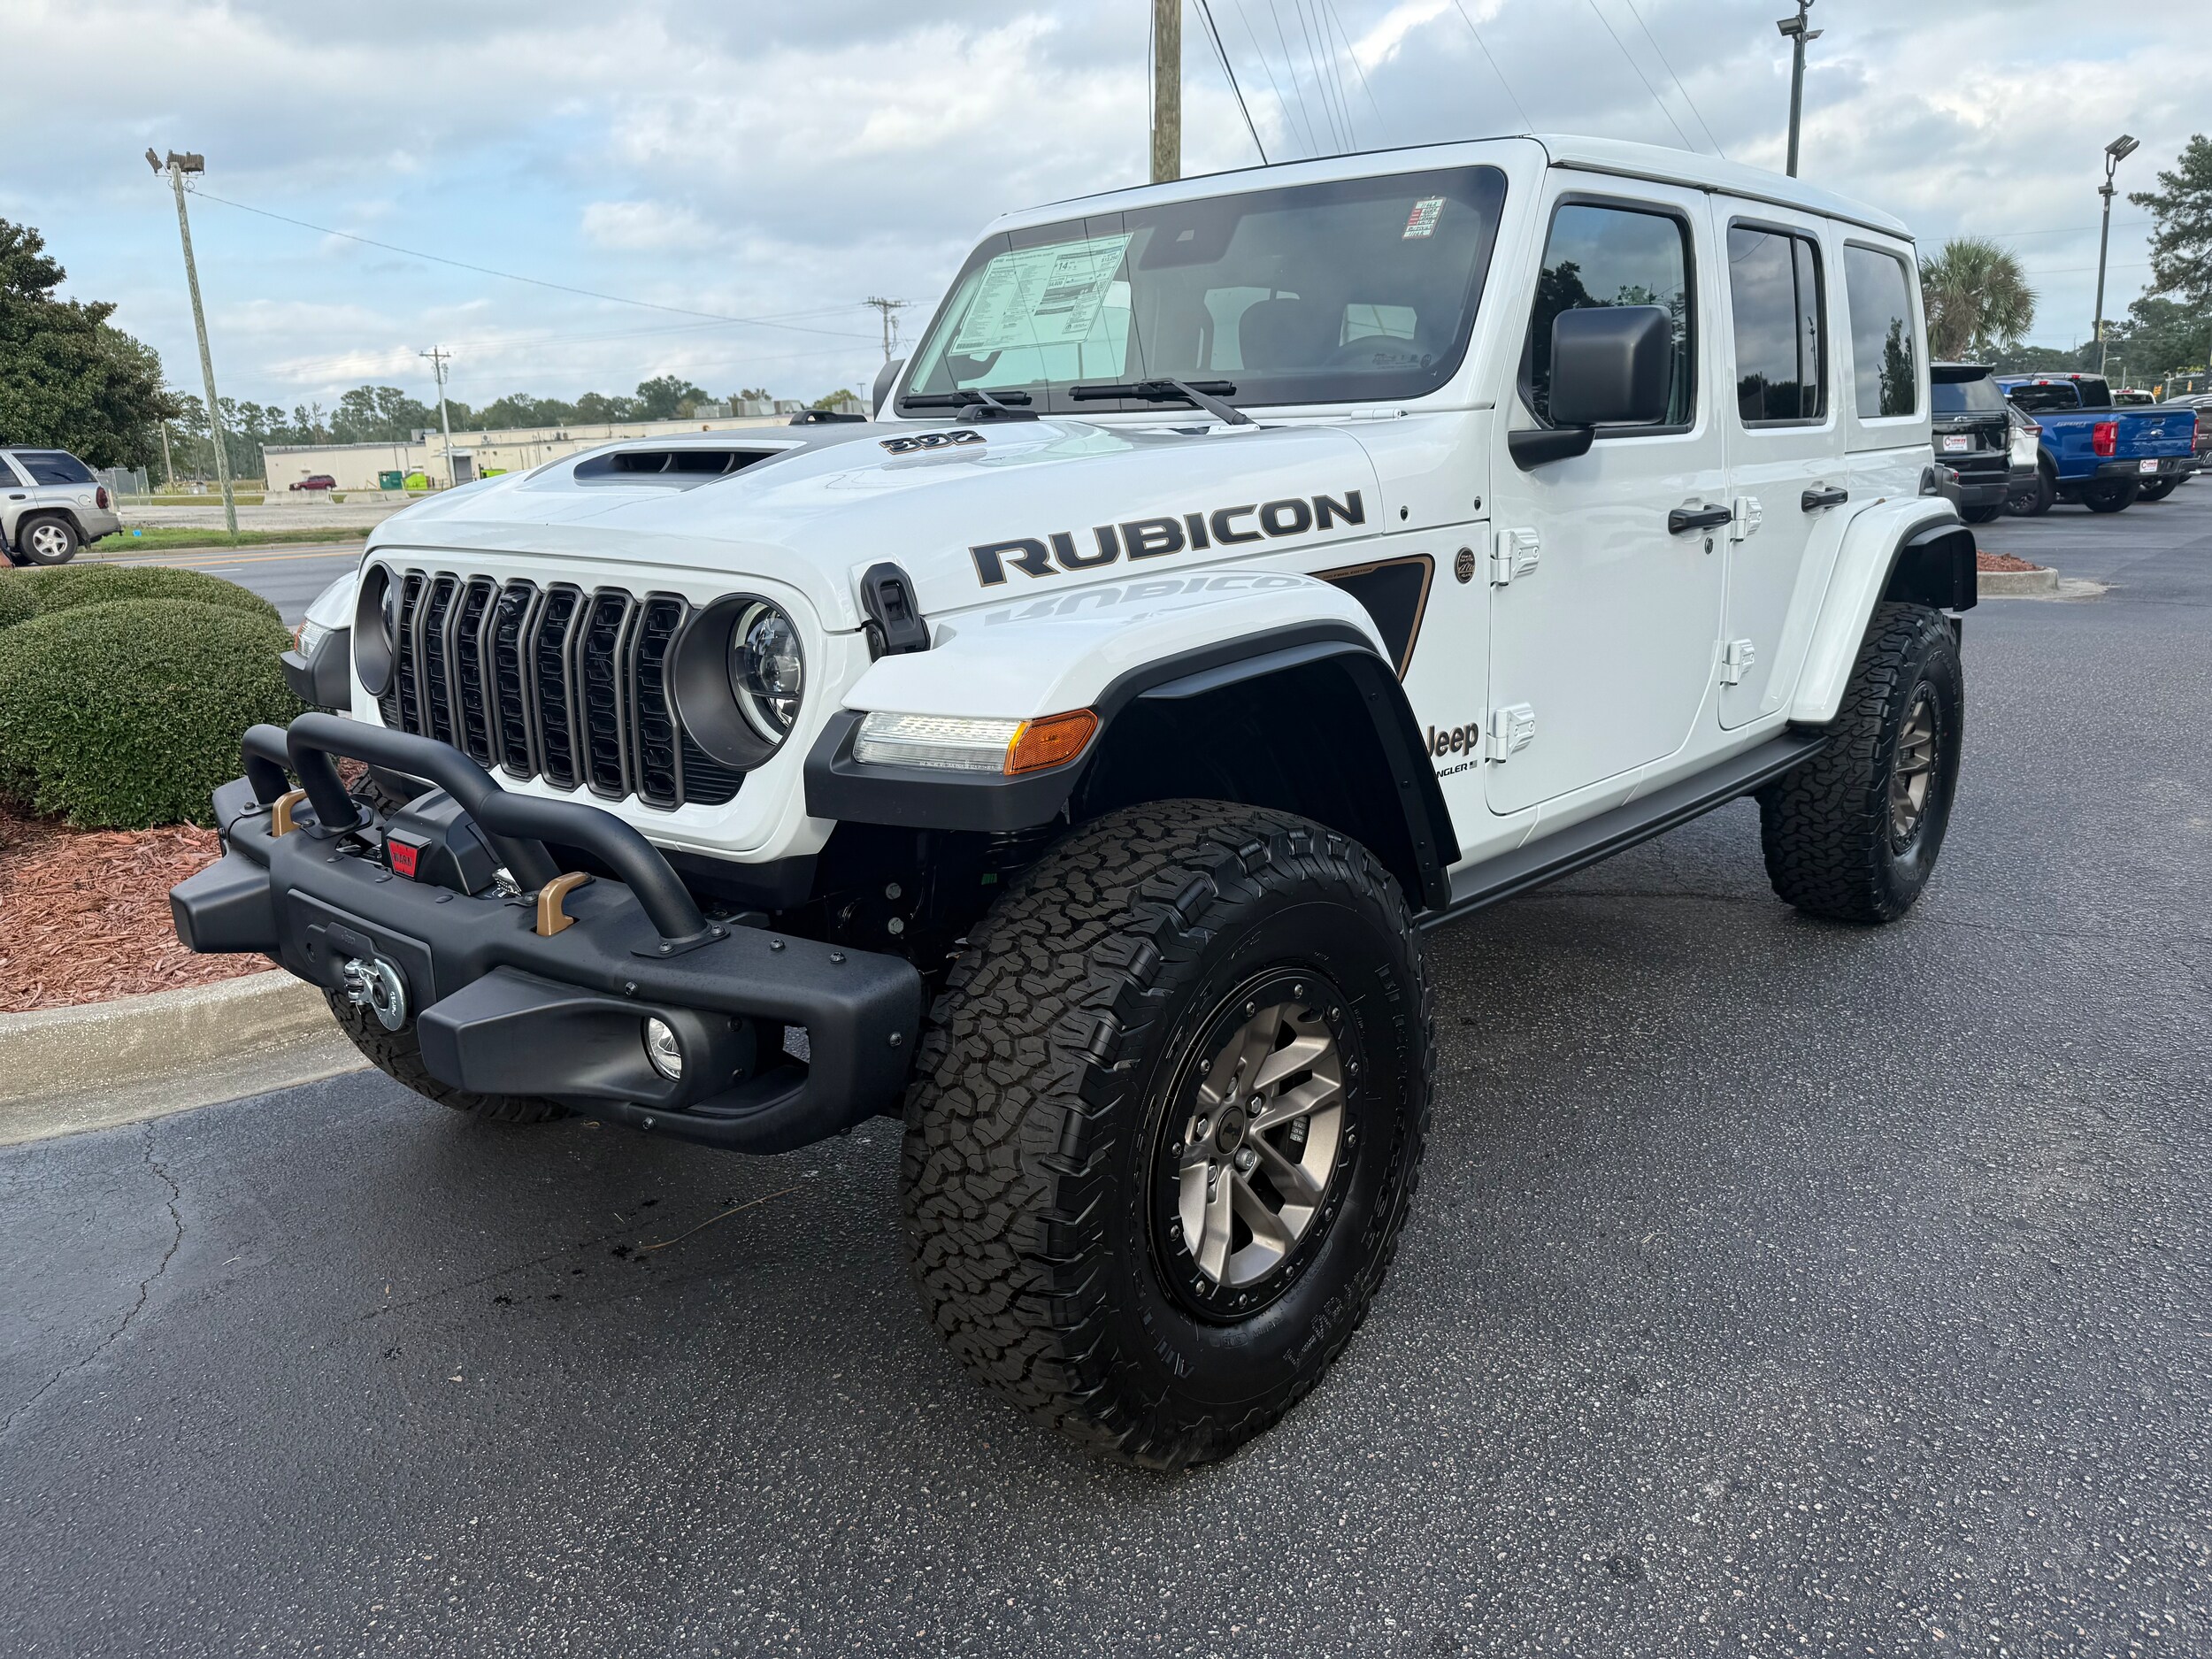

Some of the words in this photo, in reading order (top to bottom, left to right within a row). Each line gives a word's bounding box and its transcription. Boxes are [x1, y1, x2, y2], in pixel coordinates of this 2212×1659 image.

[879, 430, 987, 456] 392
[967, 489, 1367, 588] RUBICON
[1427, 722, 1479, 757] Jeep
[1436, 763, 1468, 779] NGLER
